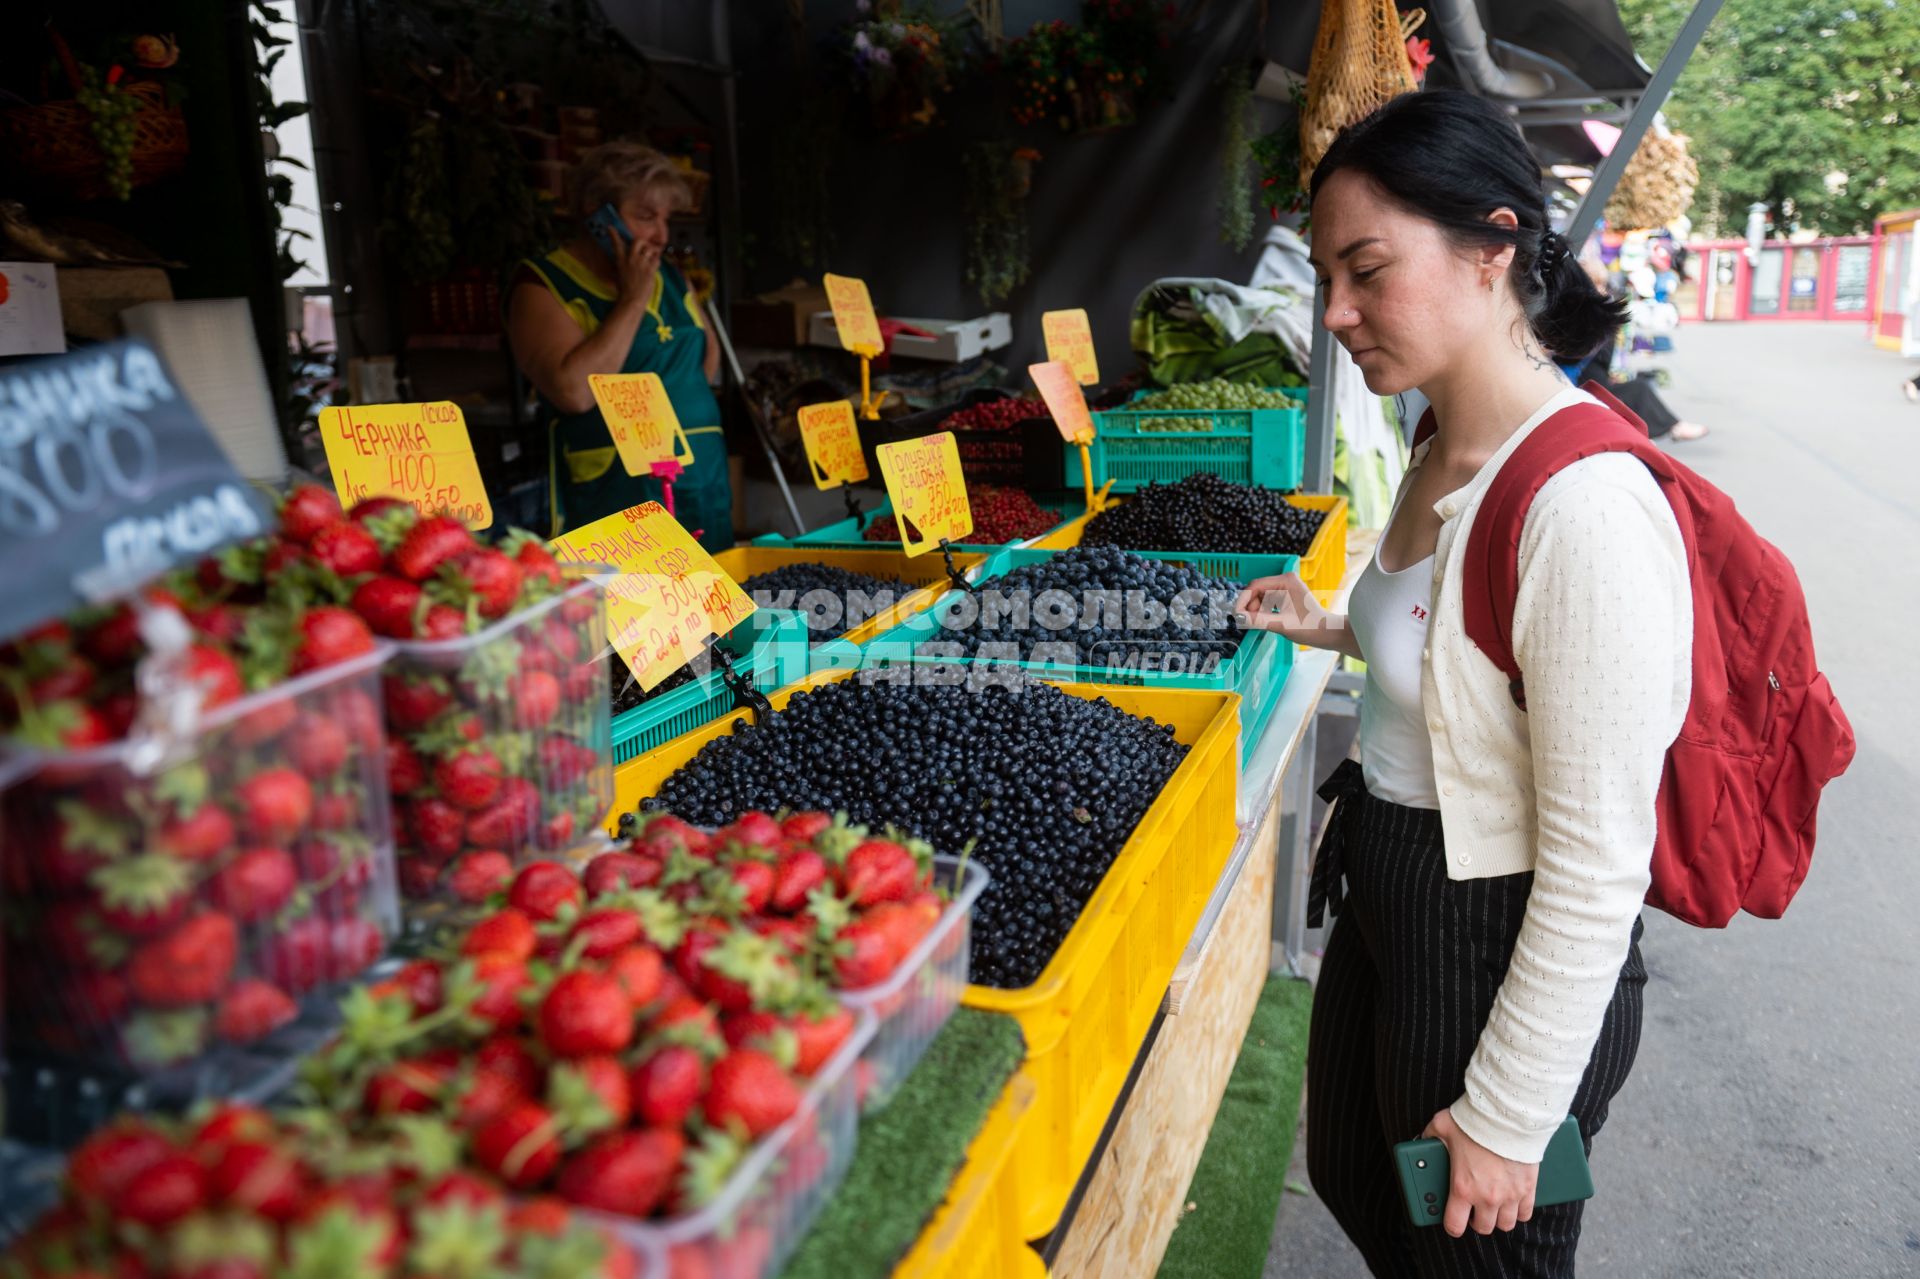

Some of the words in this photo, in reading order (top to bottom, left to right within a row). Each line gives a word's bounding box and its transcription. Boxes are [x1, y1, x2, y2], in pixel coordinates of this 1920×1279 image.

[337, 408, 432, 456] ЧЕРНИКА
[388, 453, 436, 496] 400
[885, 445, 944, 475] ГОЛУБИКА
[622, 501, 664, 524] ВКУСНАЯ
[554, 523, 662, 566] ЧЕРНИКА
[605, 567, 660, 606] УЧНОЙ
[654, 547, 690, 579] СБОР
[659, 573, 699, 617] 500
